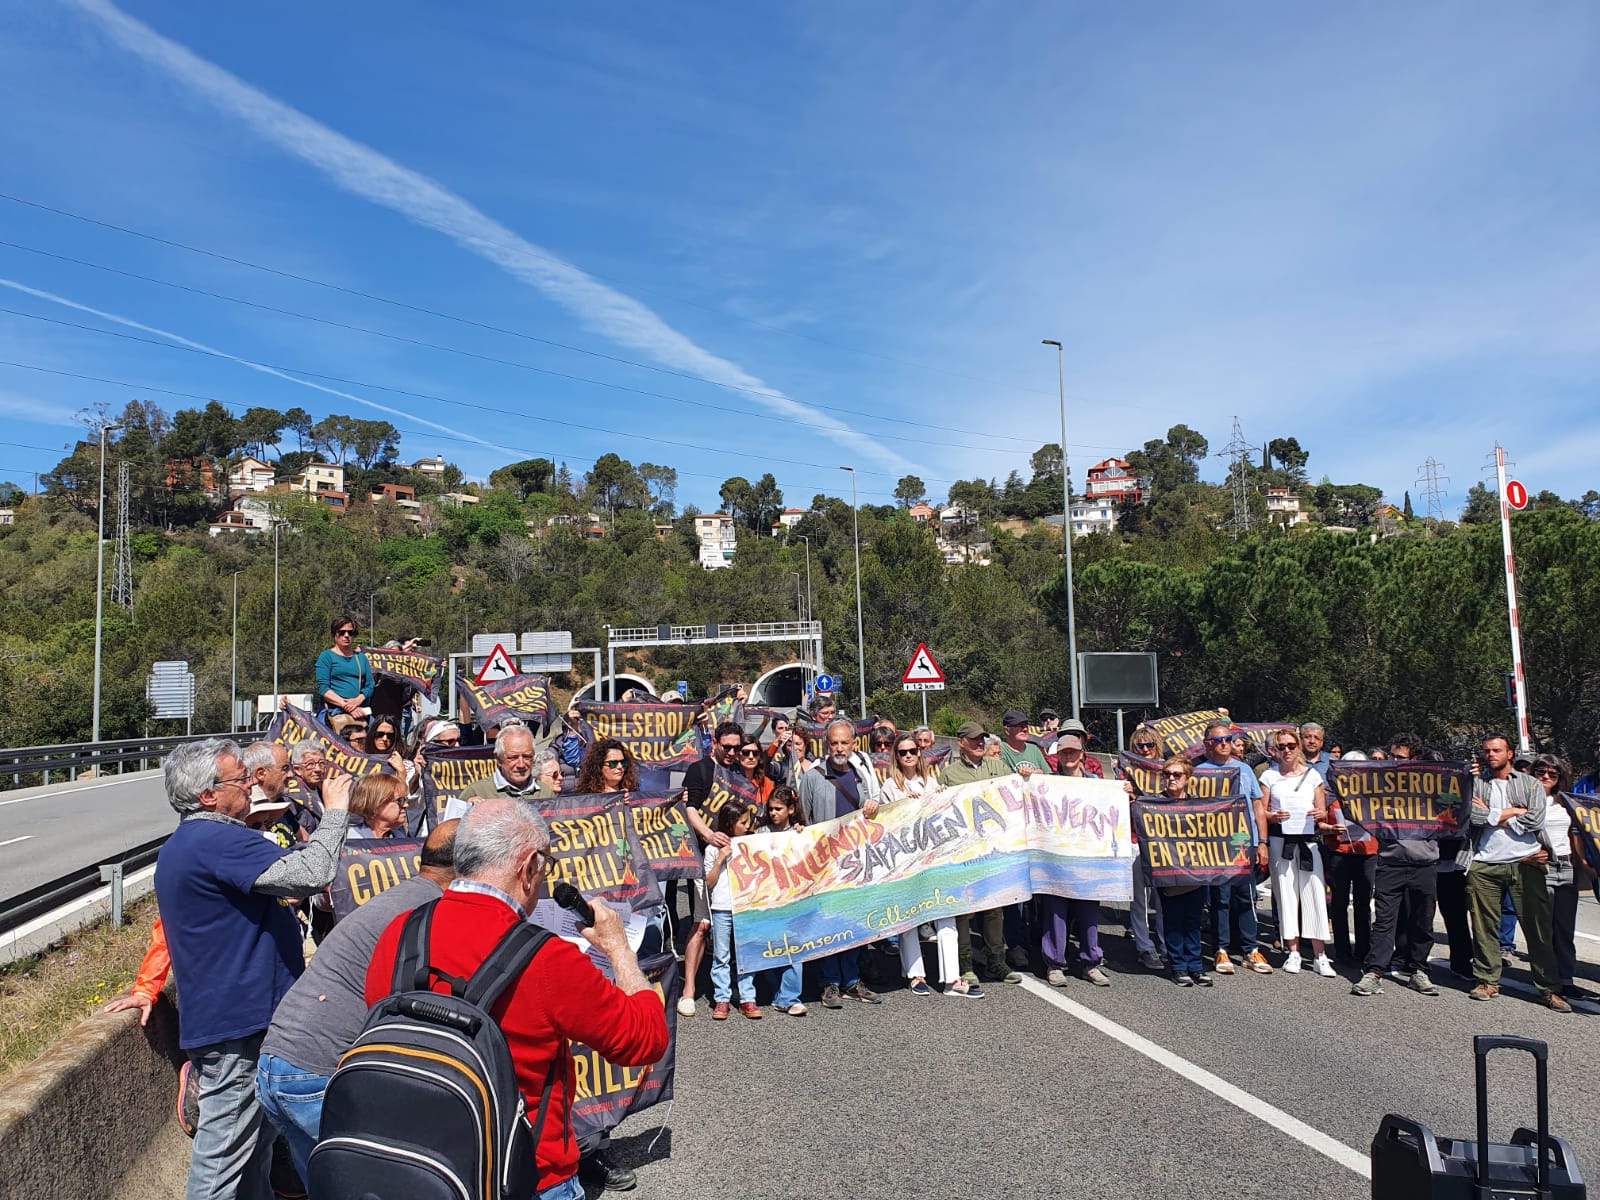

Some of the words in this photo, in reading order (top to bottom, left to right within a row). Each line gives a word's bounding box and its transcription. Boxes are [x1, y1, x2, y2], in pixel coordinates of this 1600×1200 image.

[1336, 771, 1461, 798] COLLSEROLA
[971, 797, 1007, 837] A
[1369, 796, 1438, 821] PERILL
[1142, 811, 1250, 839] COLLSEROLA
[1147, 841, 1174, 868] EN
[1175, 841, 1235, 867] PERILL
[762, 931, 855, 965] defensem
[866, 888, 961, 931] Collserola
